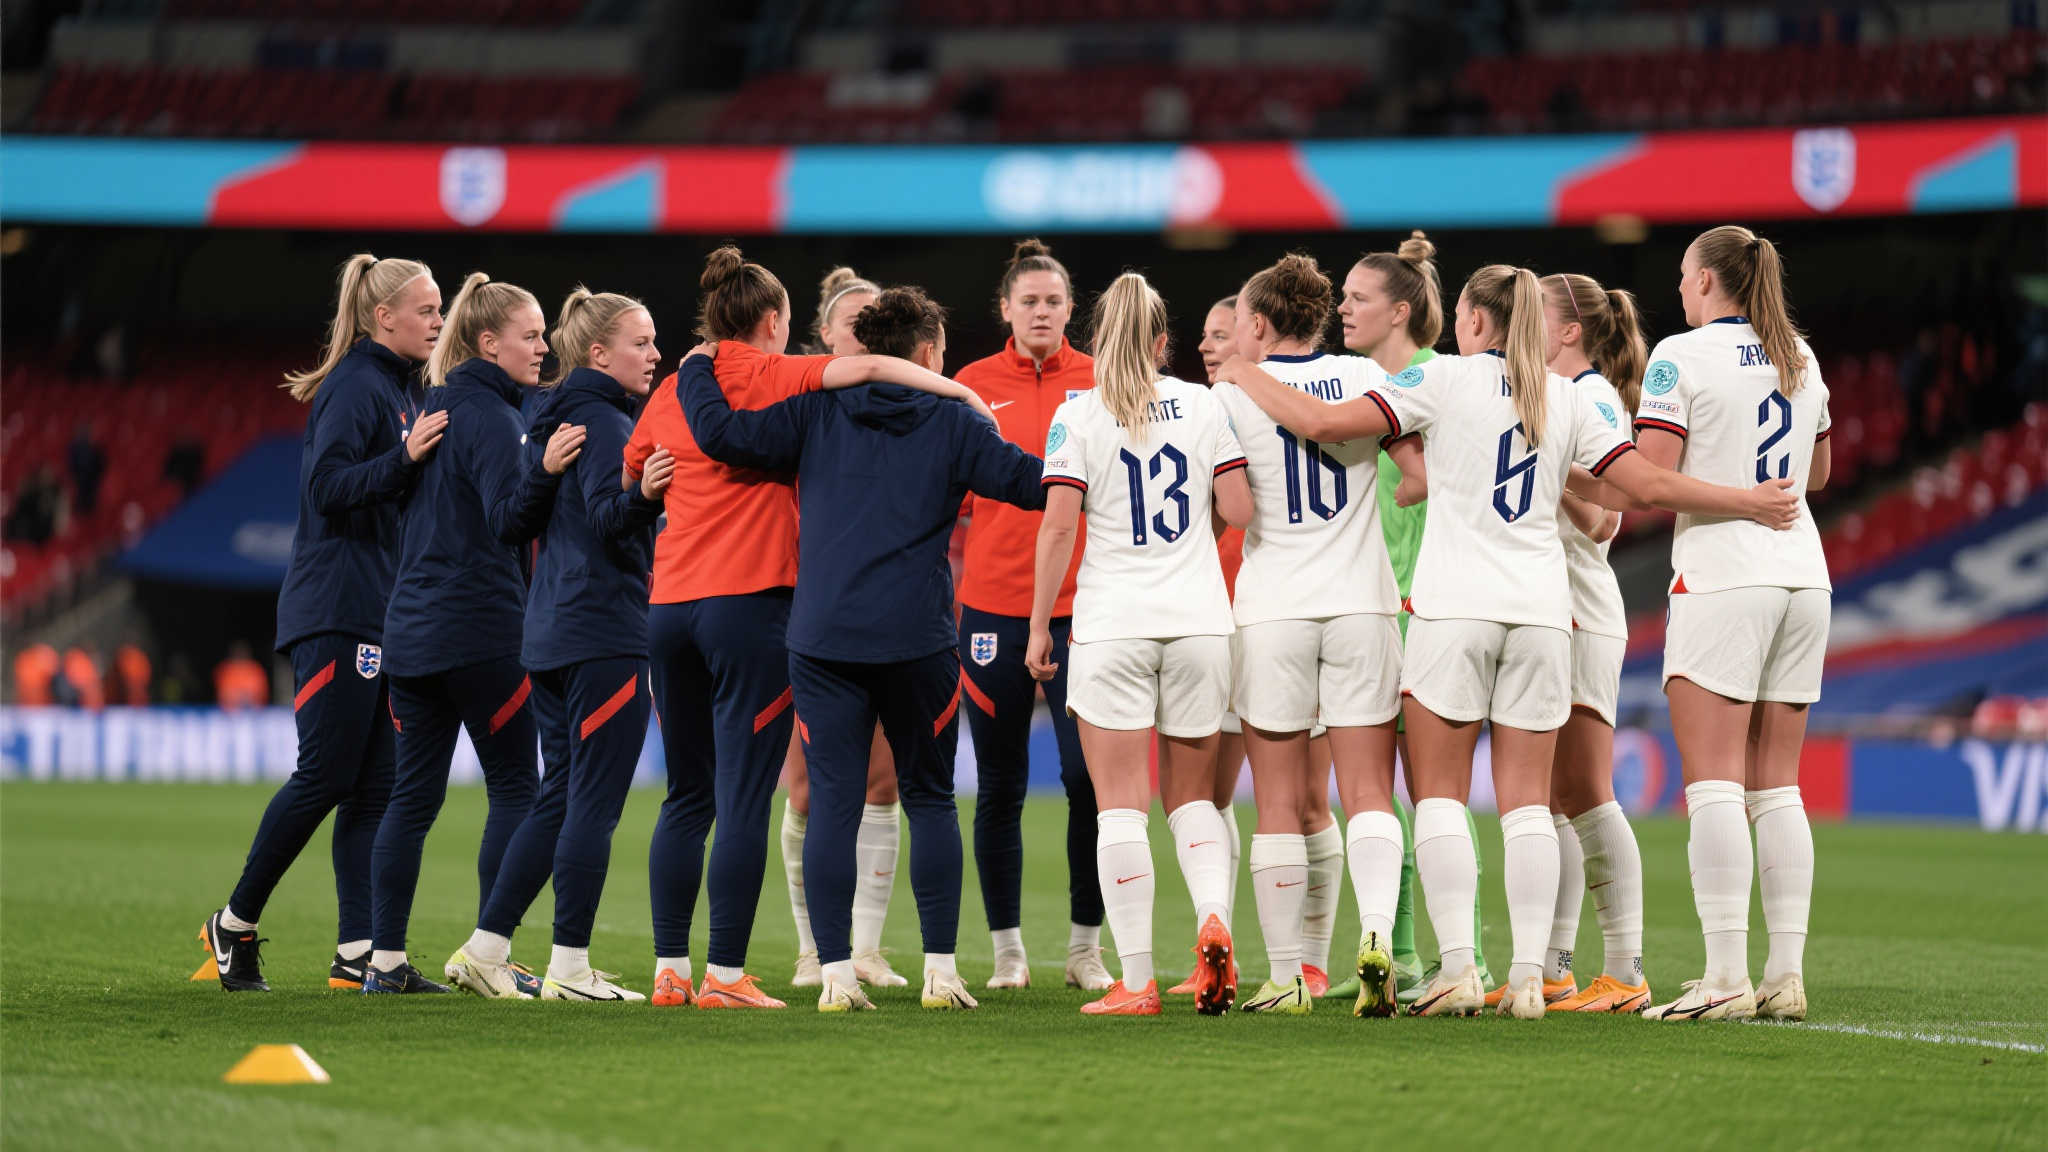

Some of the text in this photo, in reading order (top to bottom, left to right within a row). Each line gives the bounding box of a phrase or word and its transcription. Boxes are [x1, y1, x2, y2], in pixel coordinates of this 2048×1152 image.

[1276, 424, 1348, 524] 16
[1755, 388, 1792, 484] 2
[1119, 442, 1190, 546] 13
[1960, 740, 2048, 833] VI
